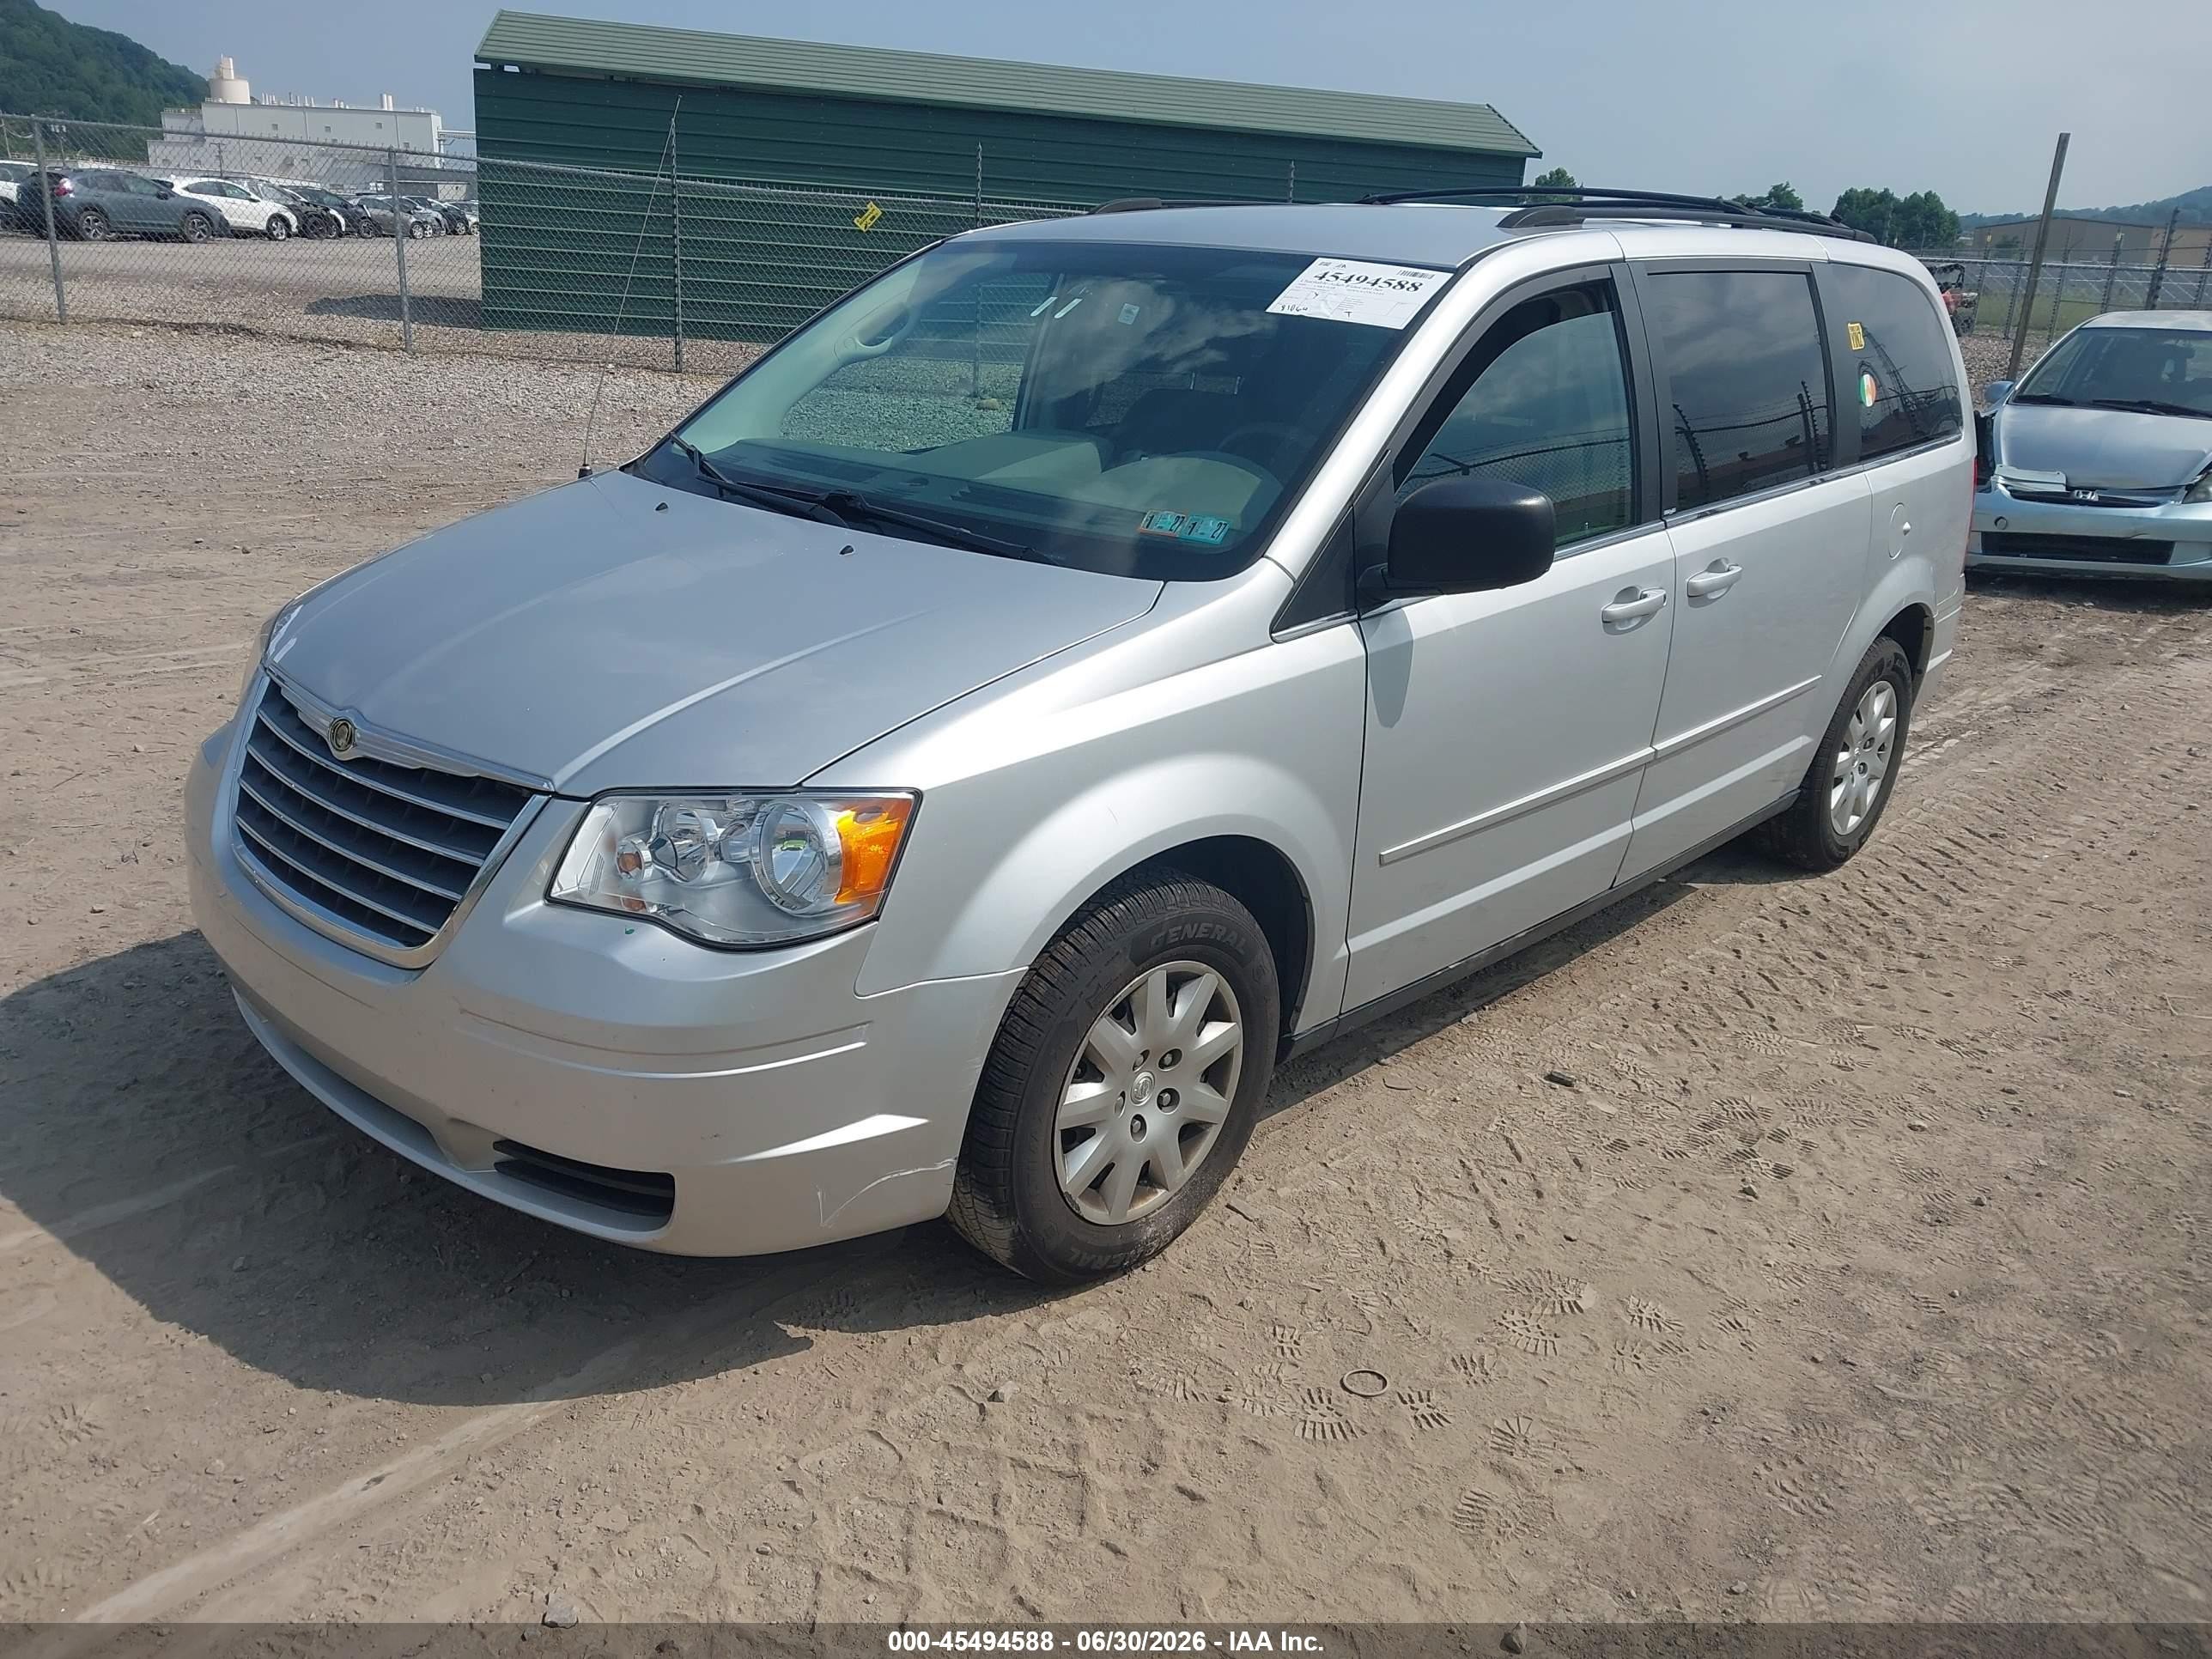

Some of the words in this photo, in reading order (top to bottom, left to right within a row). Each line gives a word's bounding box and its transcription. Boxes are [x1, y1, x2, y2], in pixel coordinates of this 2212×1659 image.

[1314, 270, 1423, 293] 45494588
[1169, 515, 1185, 533] 27
[1211, 522, 1228, 540] 27
[1150, 922, 1248, 955] GENERAL
